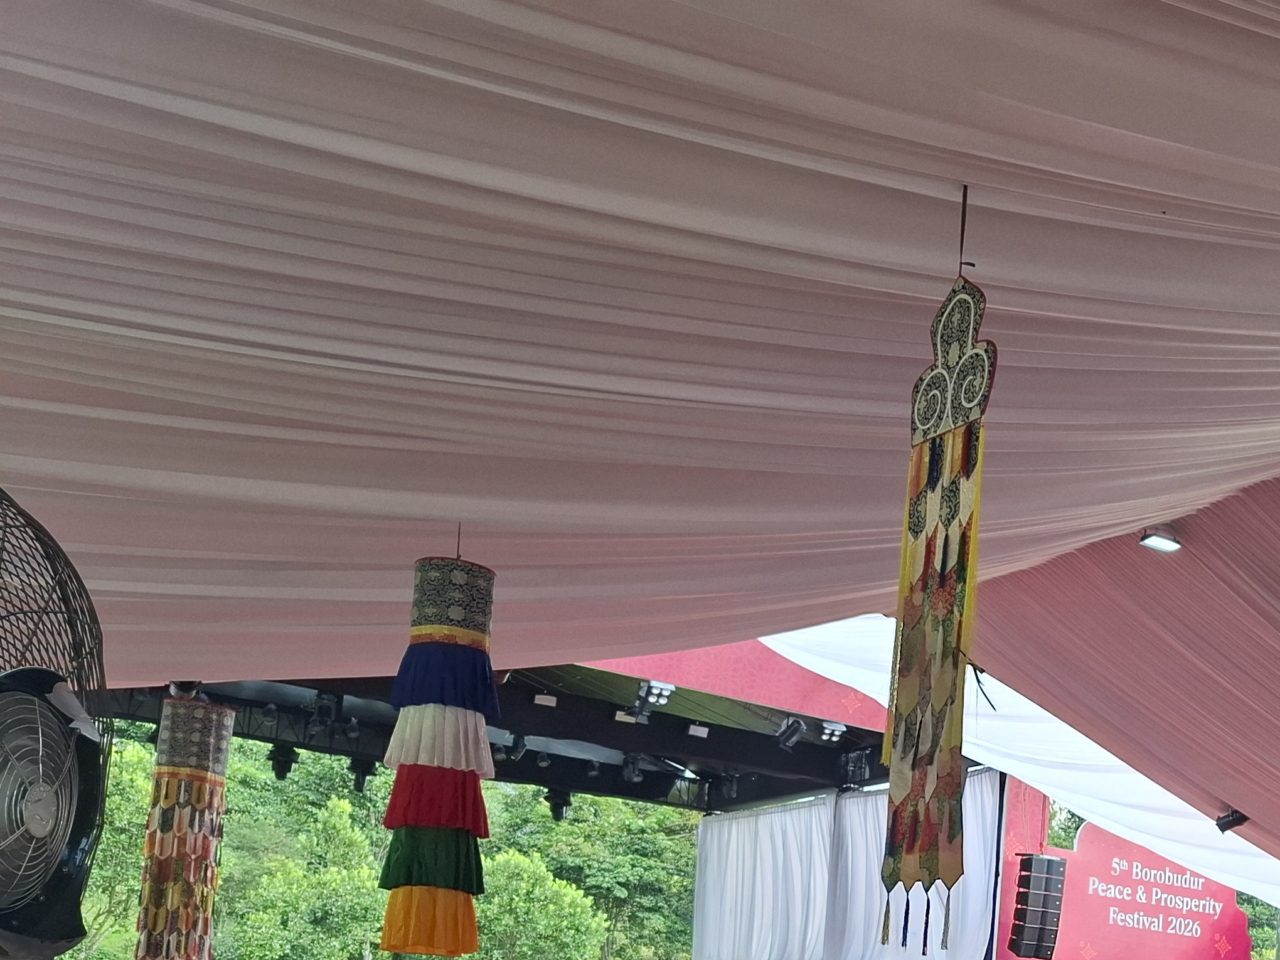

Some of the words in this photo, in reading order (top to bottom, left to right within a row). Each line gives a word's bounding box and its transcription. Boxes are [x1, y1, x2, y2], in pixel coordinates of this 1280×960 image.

[1111, 857, 1129, 876] 5th
[1132, 862, 1205, 891] Borobudur
[1088, 877, 1132, 901] Peace
[1136, 889, 1148, 904] &
[1151, 889, 1223, 919] Prosperity
[1109, 907, 1163, 933] Festival
[1167, 917, 1201, 938] 2026
